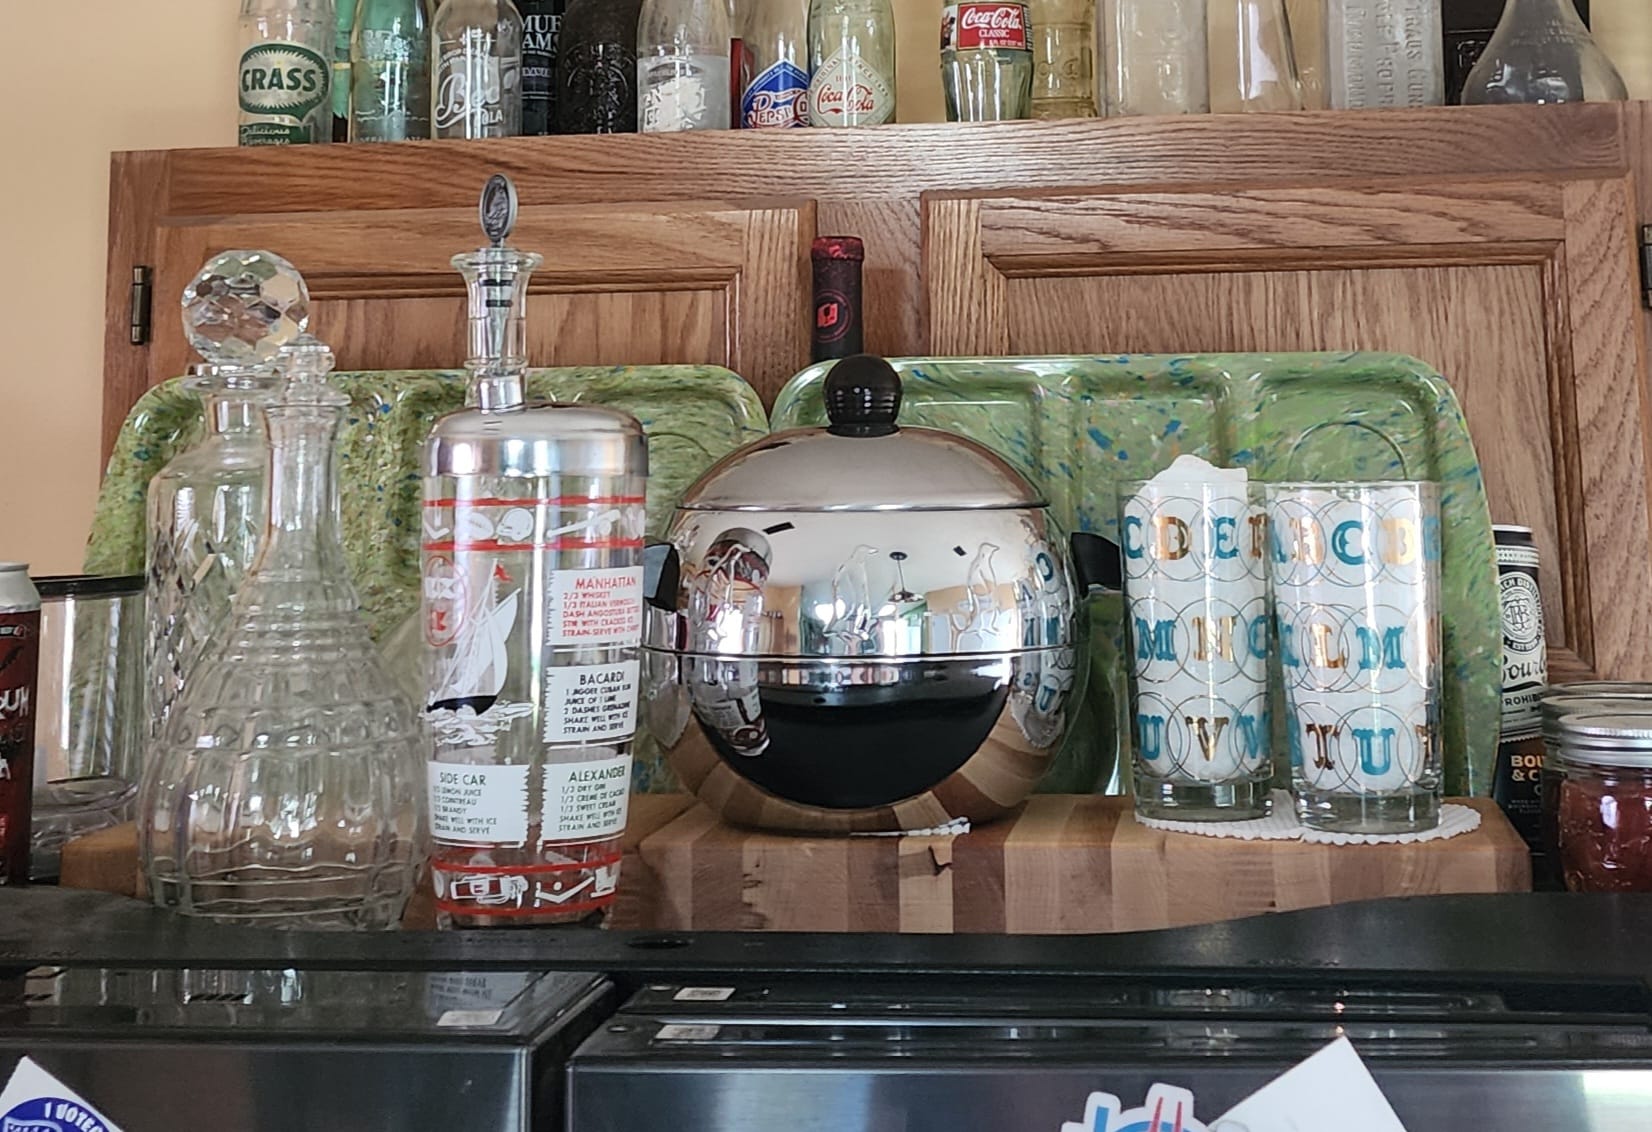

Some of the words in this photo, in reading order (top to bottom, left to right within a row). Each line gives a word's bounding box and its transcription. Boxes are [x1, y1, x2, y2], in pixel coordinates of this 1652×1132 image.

[961, 7, 1022, 30] Coca-Cola
[979, 29, 1010, 38] CLASSIC
[242, 67, 316, 92] CRASS
[575, 576, 636, 589] MANHATTAN
[562, 610, 585, 618] DASH
[580, 671, 625, 685] BACARDI
[572, 705, 600, 714] DASHES
[564, 716, 588, 725] SHAKE
[563, 726, 590, 734] STRAIN
[592, 724, 607, 732] AND
[568, 765, 625, 782] ALEXANDER
[439, 772, 459, 785] SIDE
[463, 774, 487, 786] CAR
[467, 817, 484, 825] WITH
[559, 815, 583, 823] SHAKE
[469, 827, 490, 835] SERVE
[558, 824, 585, 832] STRAIN
[587, 821, 601, 829] AND
